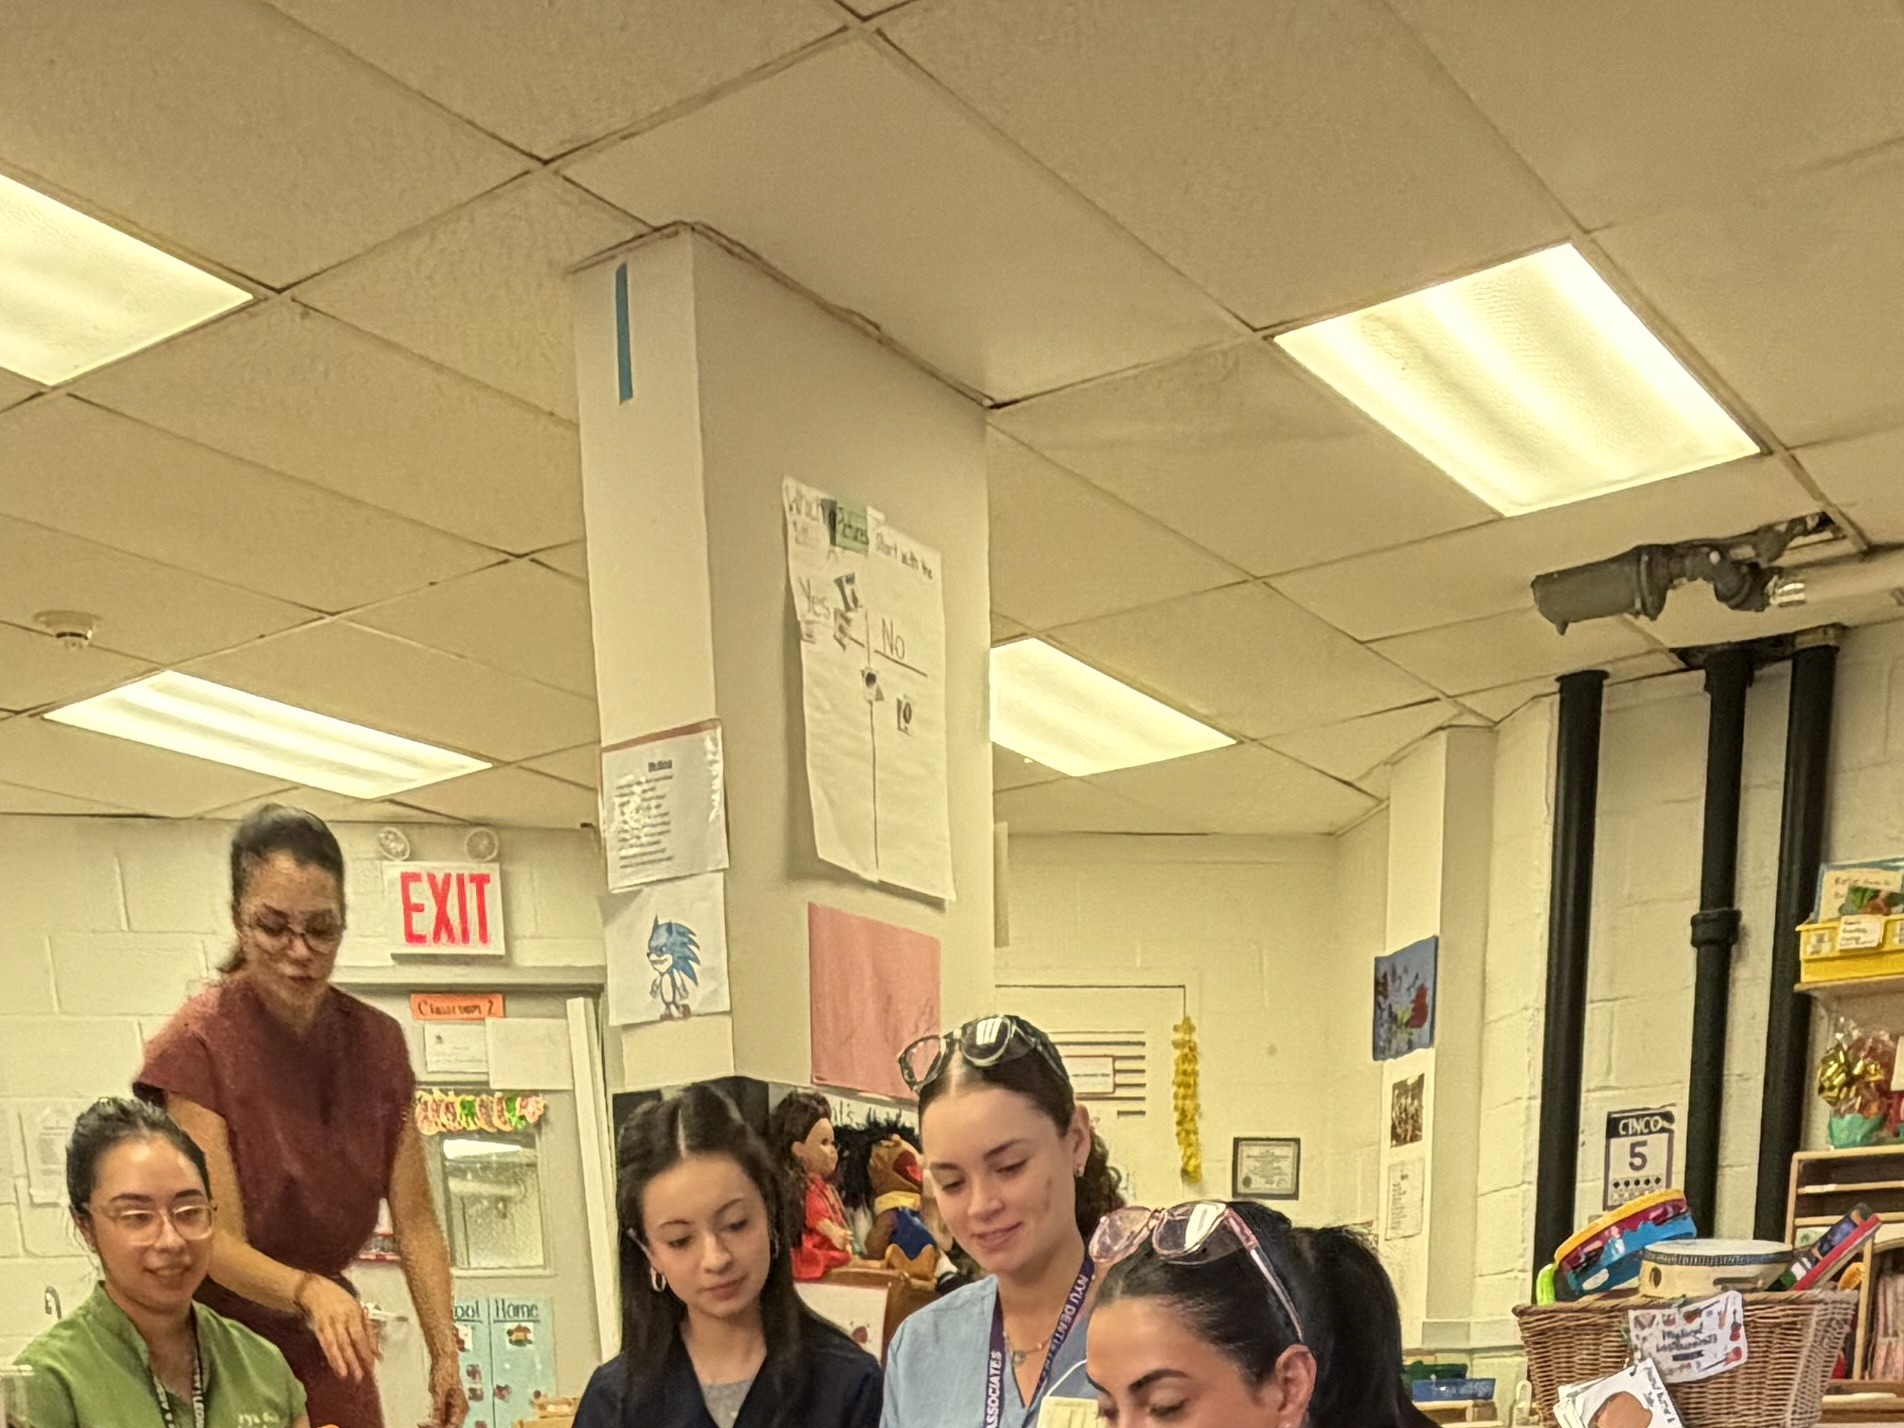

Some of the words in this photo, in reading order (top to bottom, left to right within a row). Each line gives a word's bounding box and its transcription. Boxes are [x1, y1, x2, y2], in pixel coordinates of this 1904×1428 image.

[798, 576, 830, 620] Yes
[882, 617, 906, 661] No
[400, 872, 491, 944] EXIT
[1618, 1115, 1662, 1136] CINCO
[1629, 1140, 1647, 1171] 5
[1069, 1274, 1089, 1303] NYU
[495, 1298, 540, 1319] Home
